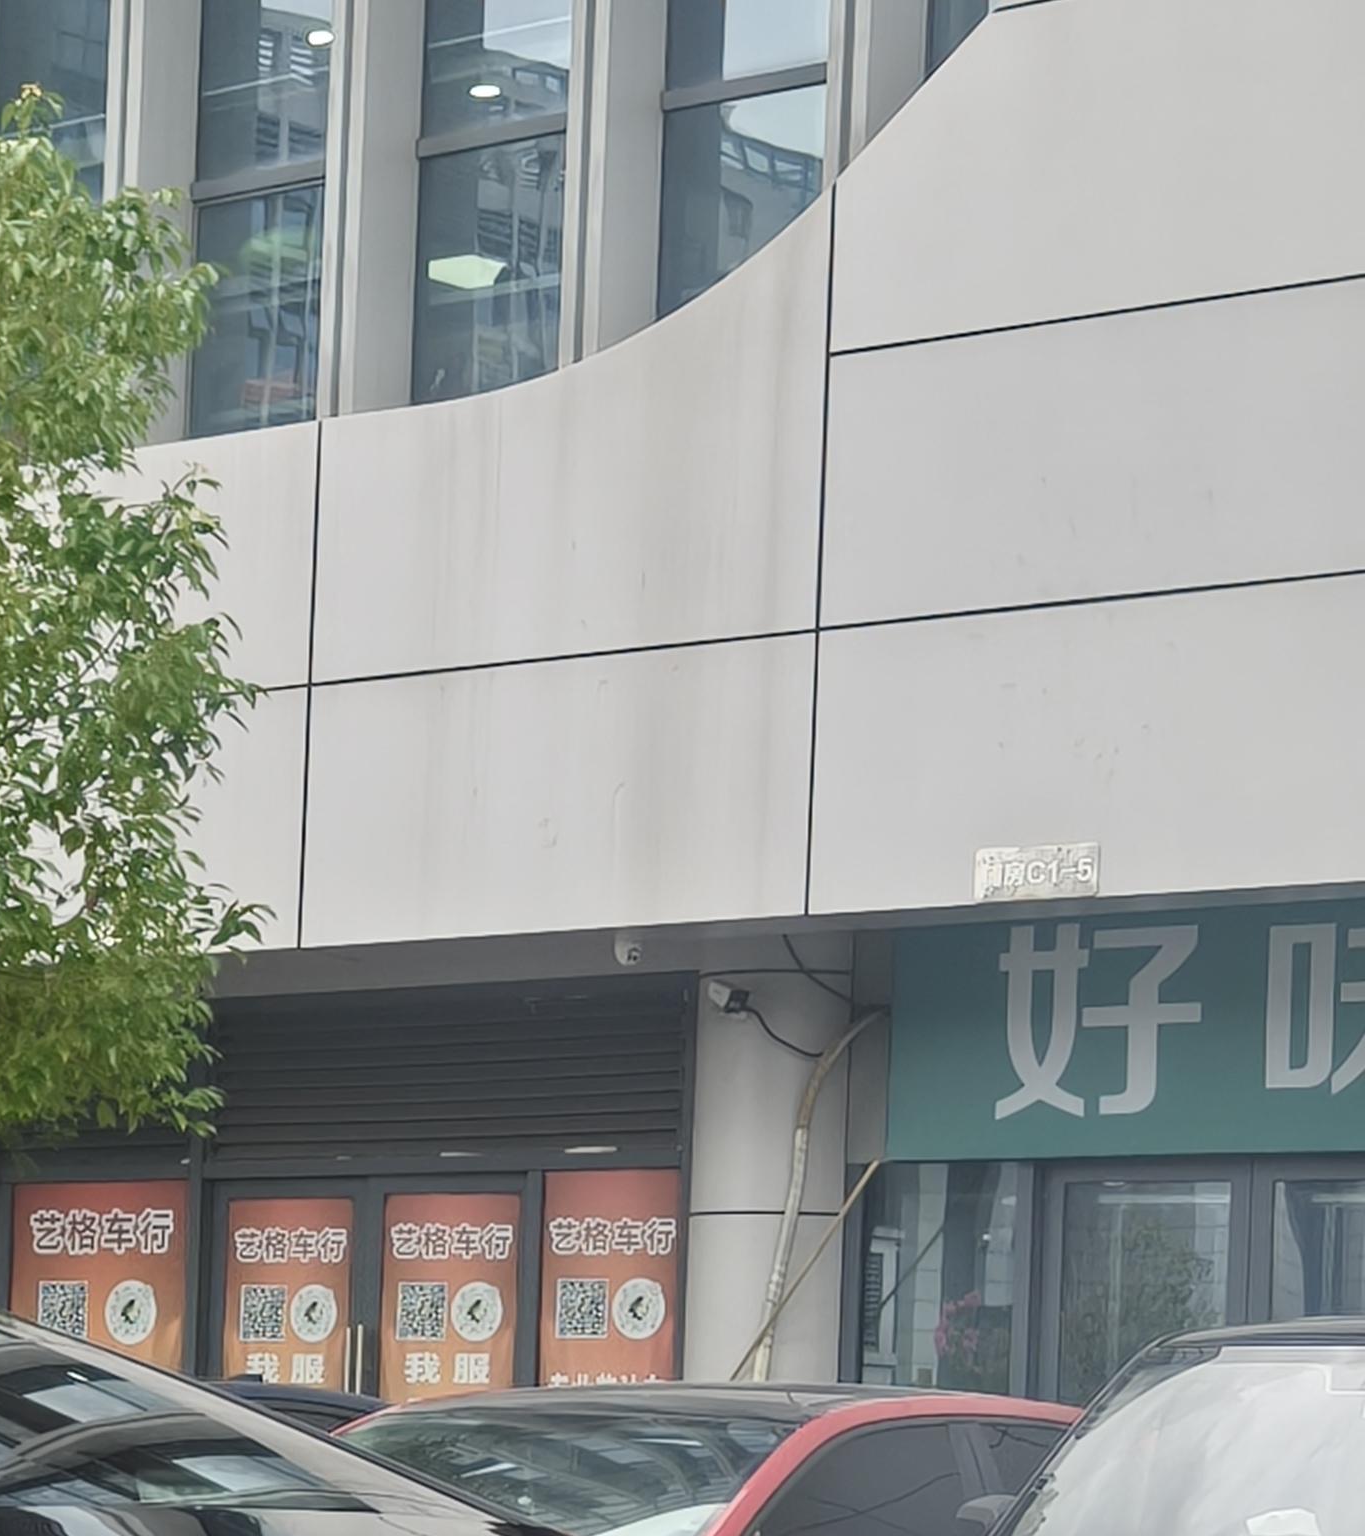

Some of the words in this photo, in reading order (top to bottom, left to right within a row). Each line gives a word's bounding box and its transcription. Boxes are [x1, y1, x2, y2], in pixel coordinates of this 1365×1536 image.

[31, 1208, 173, 1255] 艺格车行
[234, 1227, 347, 1263] 艺格车行
[391, 1223, 513, 1259] 艺格车行
[549, 1217, 676, 1256] 艺格车行
